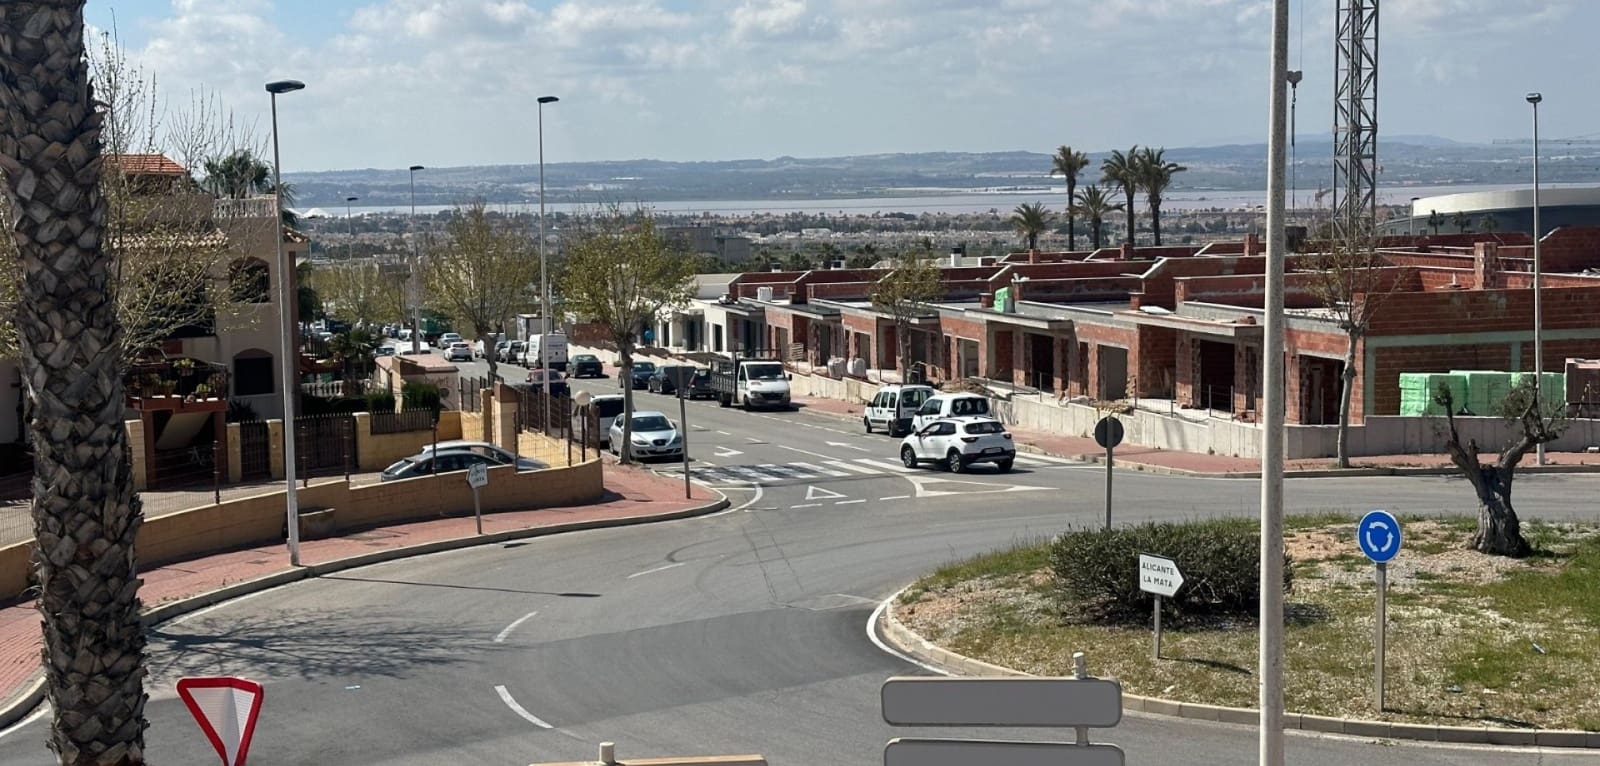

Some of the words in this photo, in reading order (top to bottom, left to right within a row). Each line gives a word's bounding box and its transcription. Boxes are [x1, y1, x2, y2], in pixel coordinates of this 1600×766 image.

[1141, 562, 1174, 575] ALICANTE
[1143, 575, 1152, 583] LA
[1153, 577, 1173, 587] MATA
